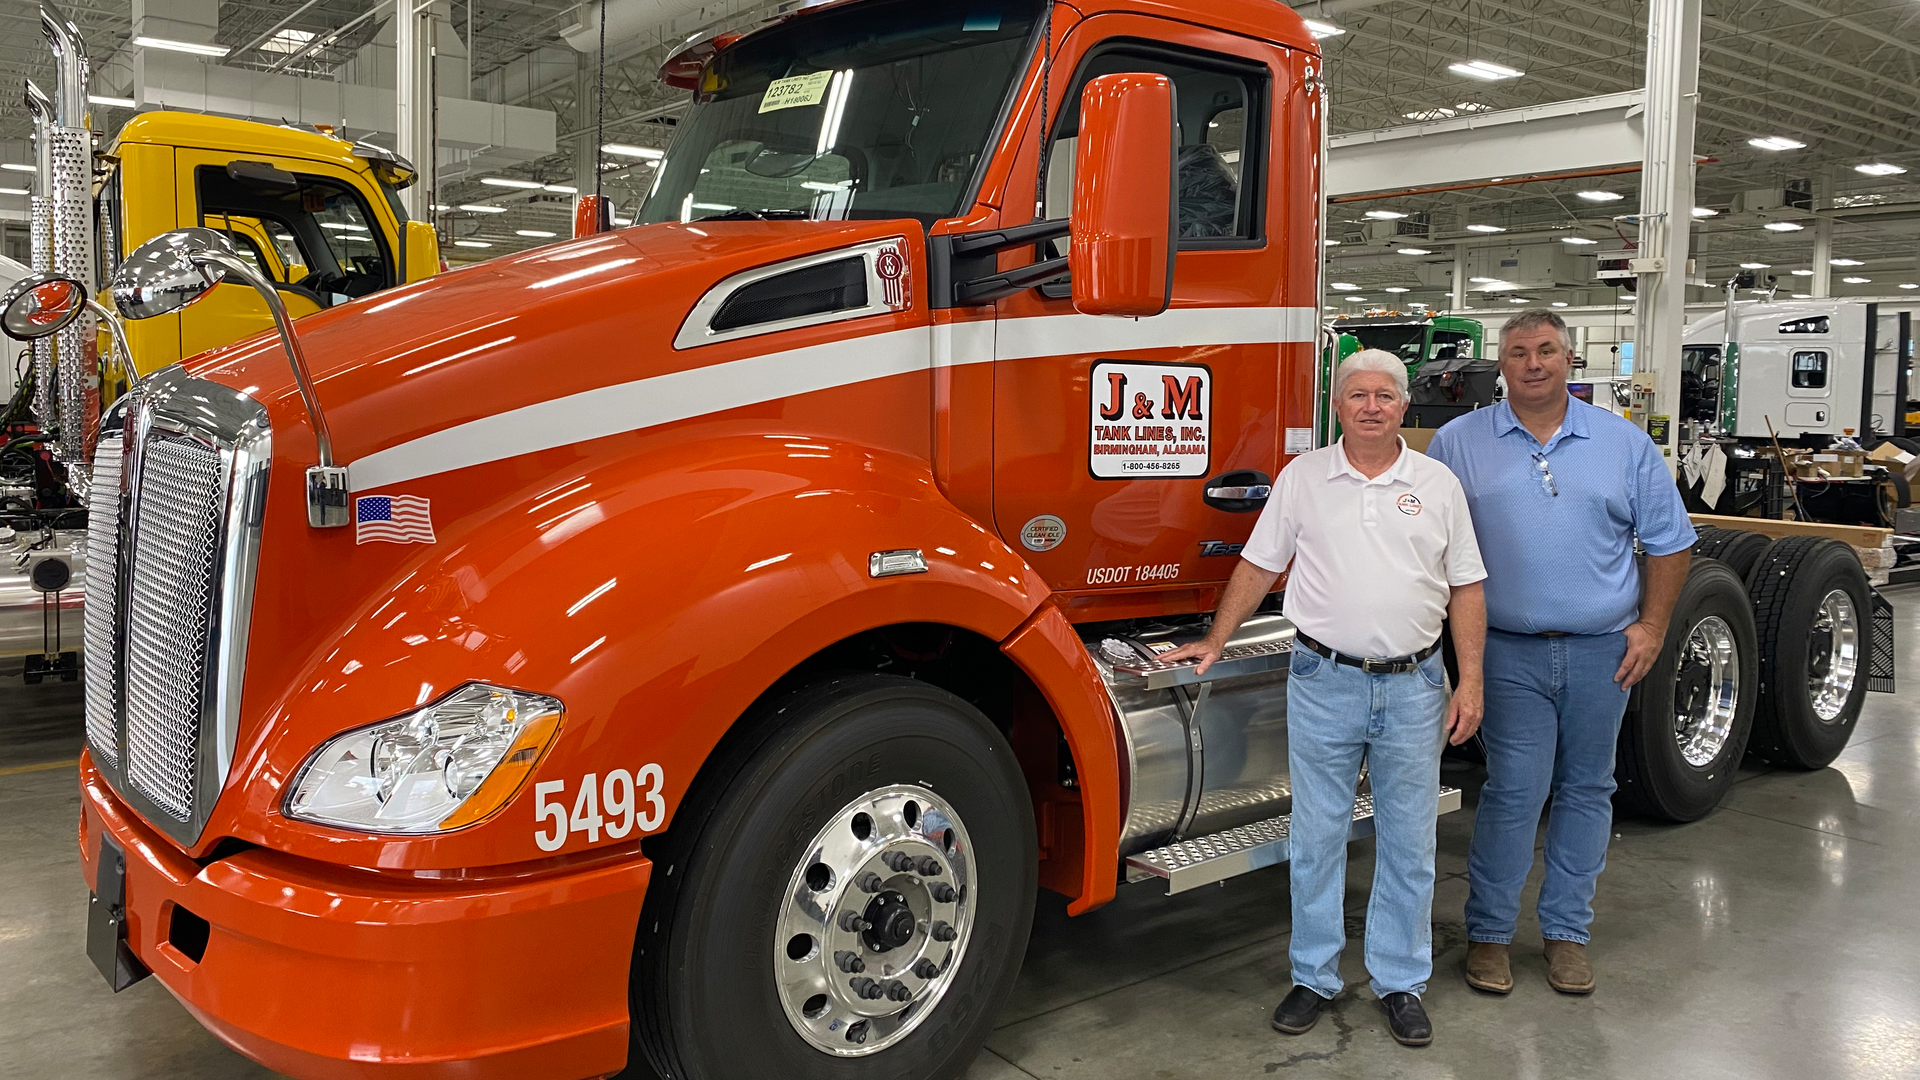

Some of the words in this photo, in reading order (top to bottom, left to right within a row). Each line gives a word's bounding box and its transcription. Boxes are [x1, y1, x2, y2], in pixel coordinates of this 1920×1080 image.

[767, 83, 804, 98] 123782
[1100, 372, 1128, 421] J
[1132, 392, 1154, 420] &
[1161, 375, 1203, 421] M
[1095, 425, 1132, 441] TANK
[1134, 426, 1177, 444] LINES,
[1180, 426, 1206, 441] INC.
[1093, 443, 1160, 457] BIRMINGHAM,
[1161, 444, 1207, 455] ALABAMA
[1122, 462, 1181, 471] 1-800-456-8265
[1198, 540, 1244, 557] T68
[1086, 566, 1132, 585] USDOT
[1135, 563, 1180, 582] 184405
[534, 763, 666, 852] 5493
